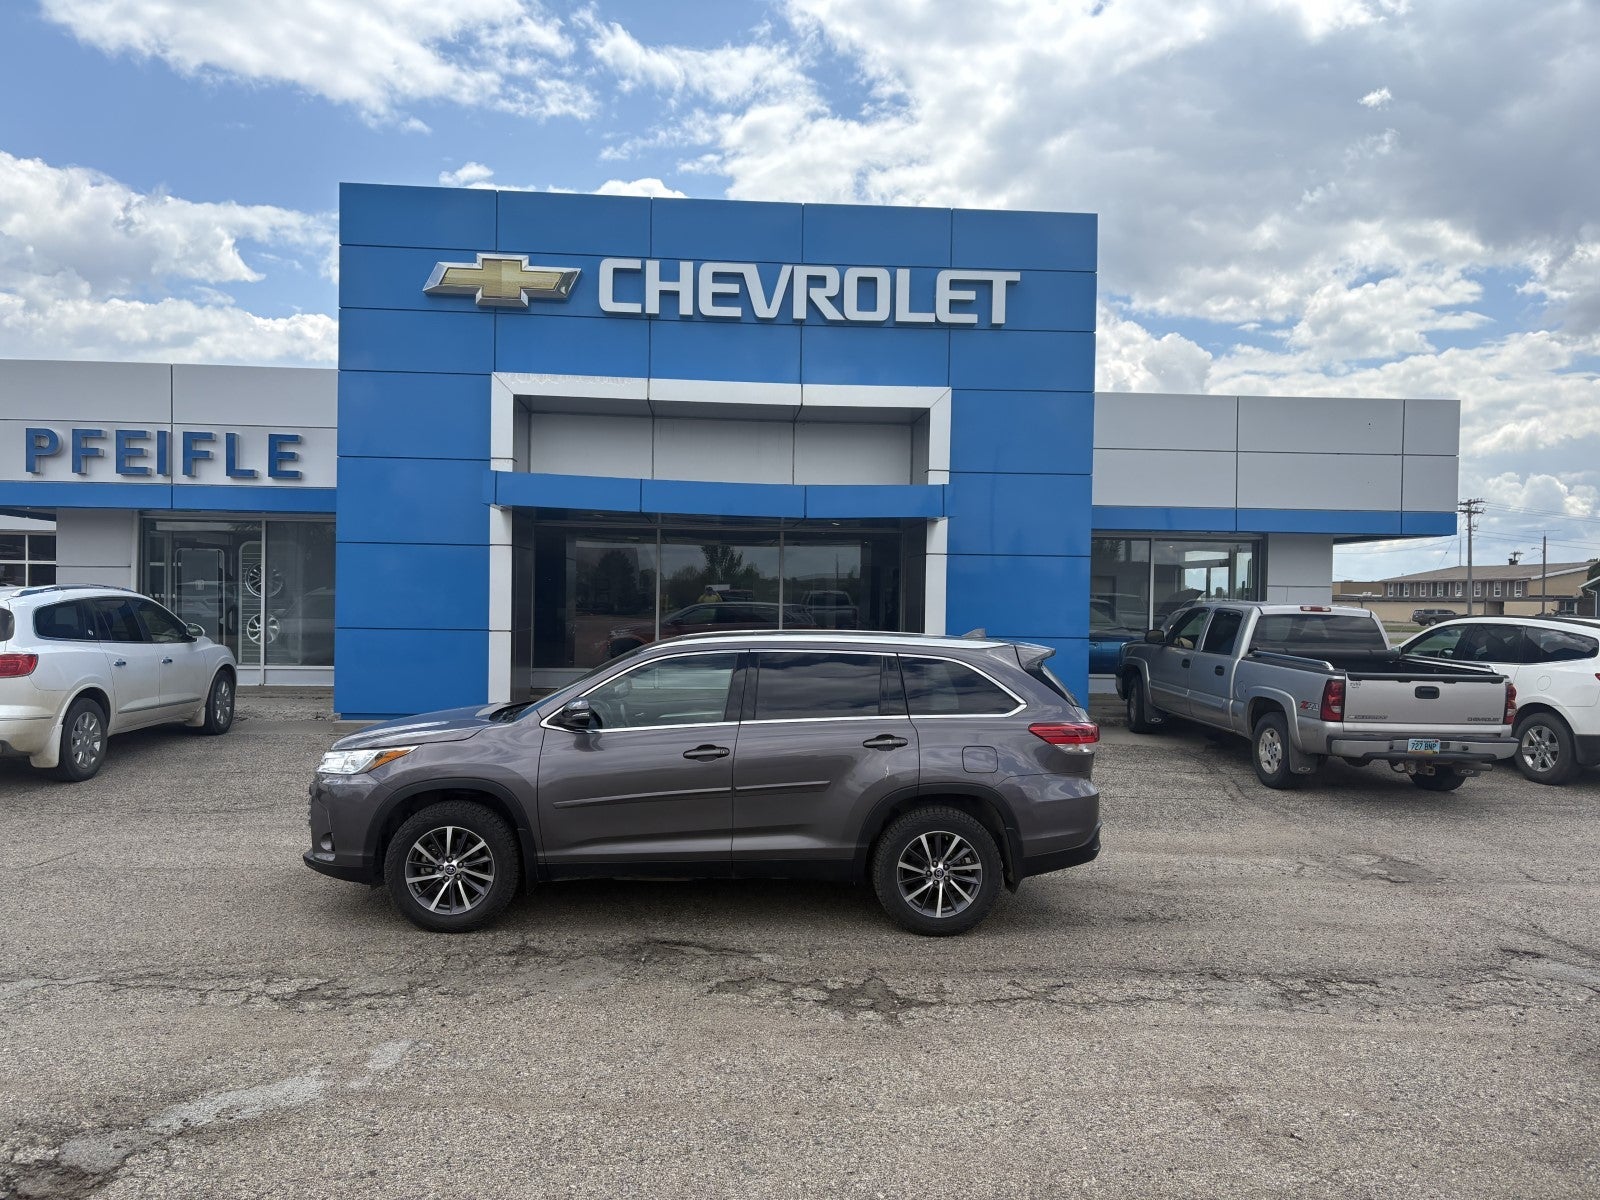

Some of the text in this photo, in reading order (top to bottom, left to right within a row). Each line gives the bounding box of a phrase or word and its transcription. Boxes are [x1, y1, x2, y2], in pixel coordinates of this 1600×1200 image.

[599, 258, 1020, 324] CHEVROLET
[25, 428, 303, 478] PFEIFLE
[1411, 742, 1423, 751] 727
